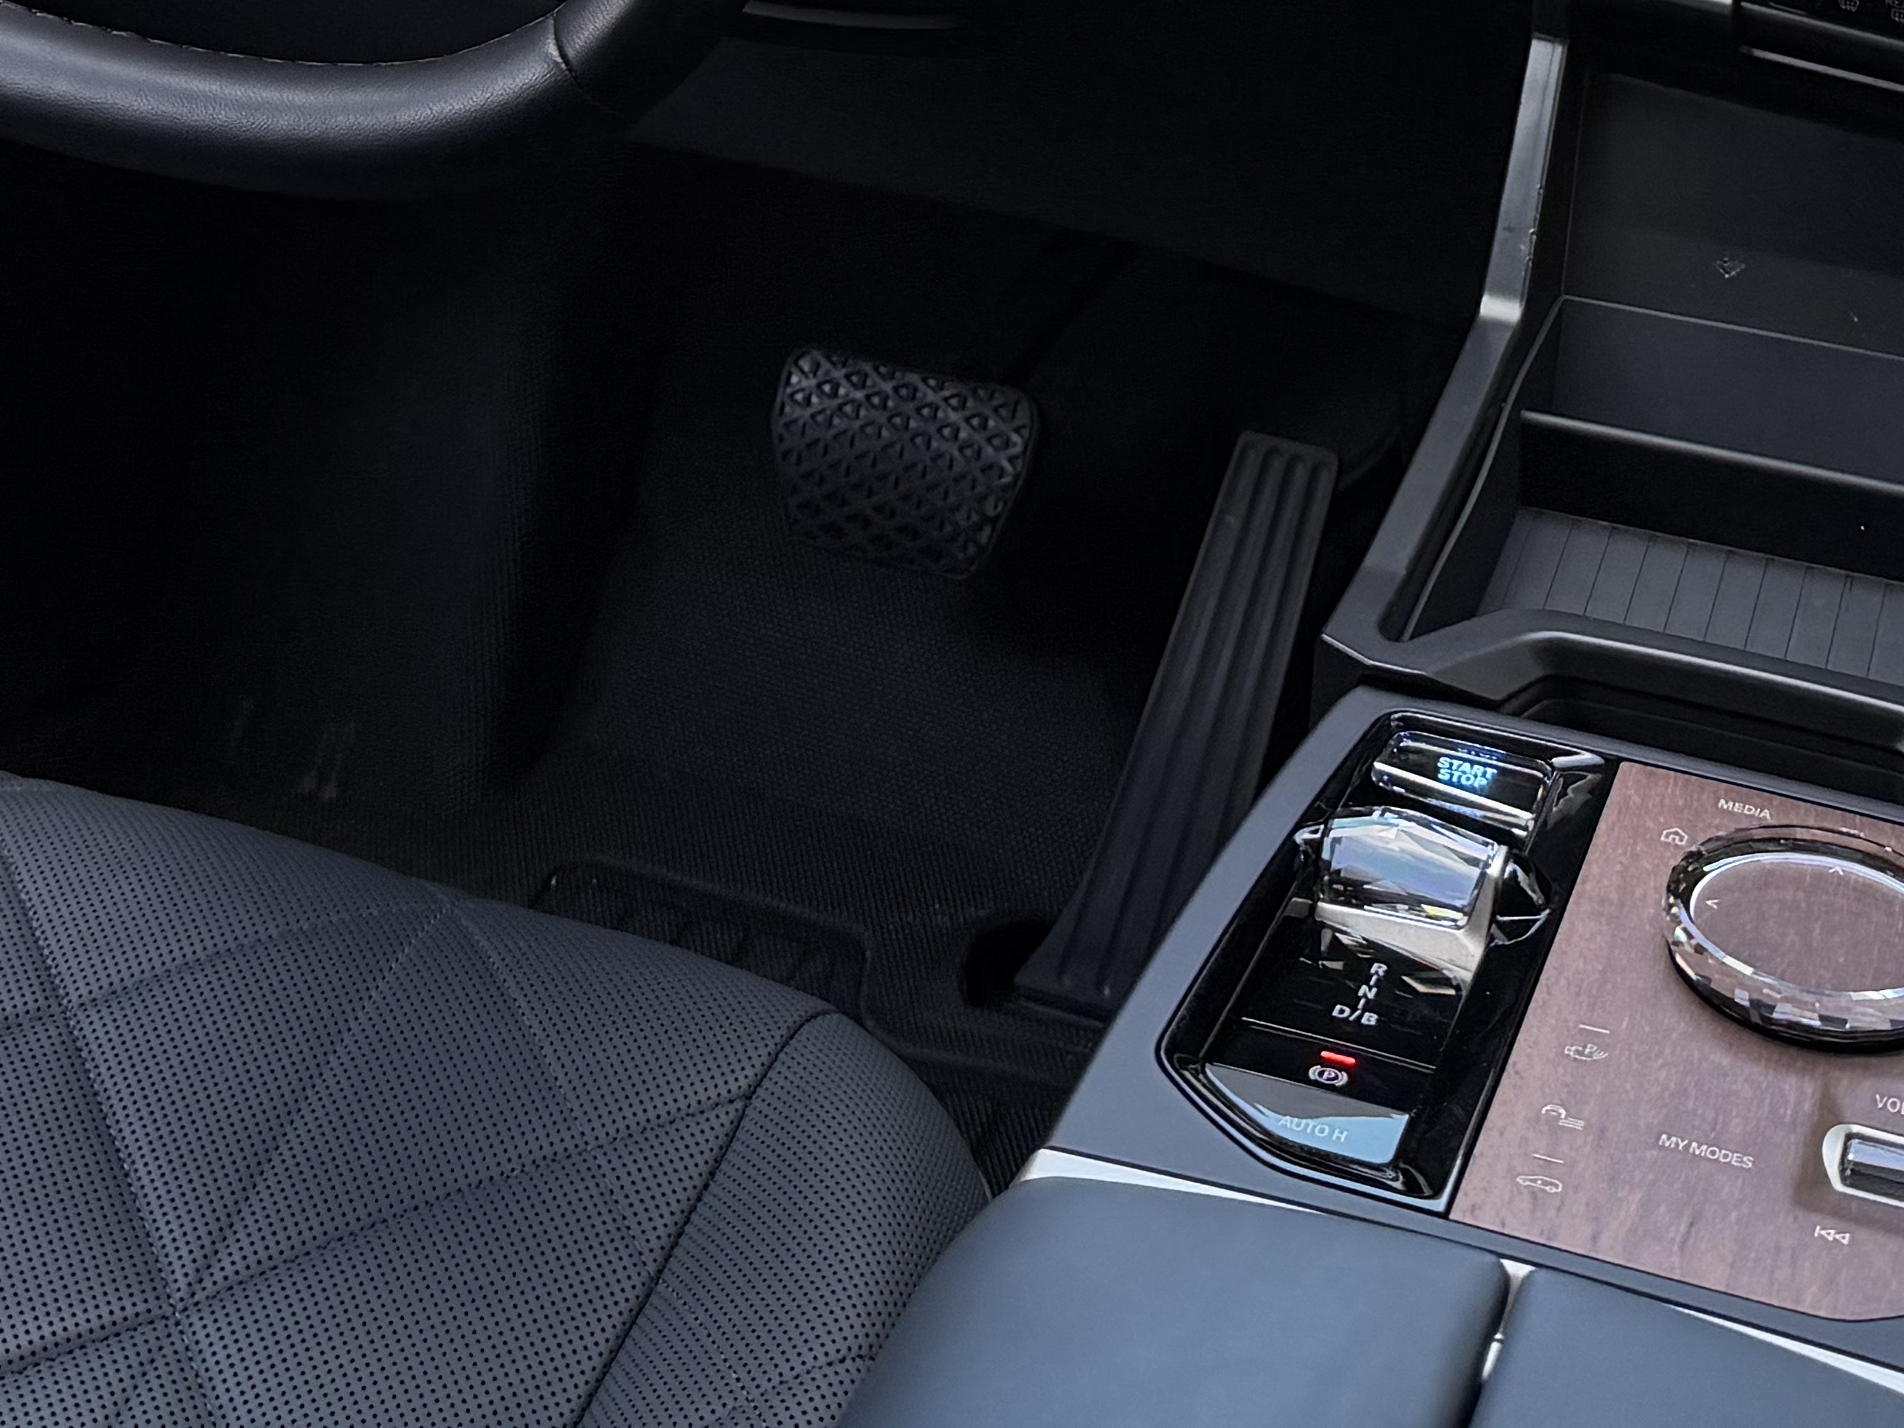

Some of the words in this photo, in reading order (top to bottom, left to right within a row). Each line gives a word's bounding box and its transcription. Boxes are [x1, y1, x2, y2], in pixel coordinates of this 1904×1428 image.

[1437, 757, 1497, 780] START
[1437, 769, 1489, 788] STOP
[1717, 798, 1772, 821] MEDIA
[1370, 962, 1388, 977] R
[1357, 984, 1378, 999] N
[1332, 1004, 1379, 1026] D/B
[1278, 1115, 1329, 1137] AUTO
[1332, 1128, 1349, 1143] H
[1658, 1133, 1688, 1152] MY
[1689, 1141, 1754, 1170] MODES
